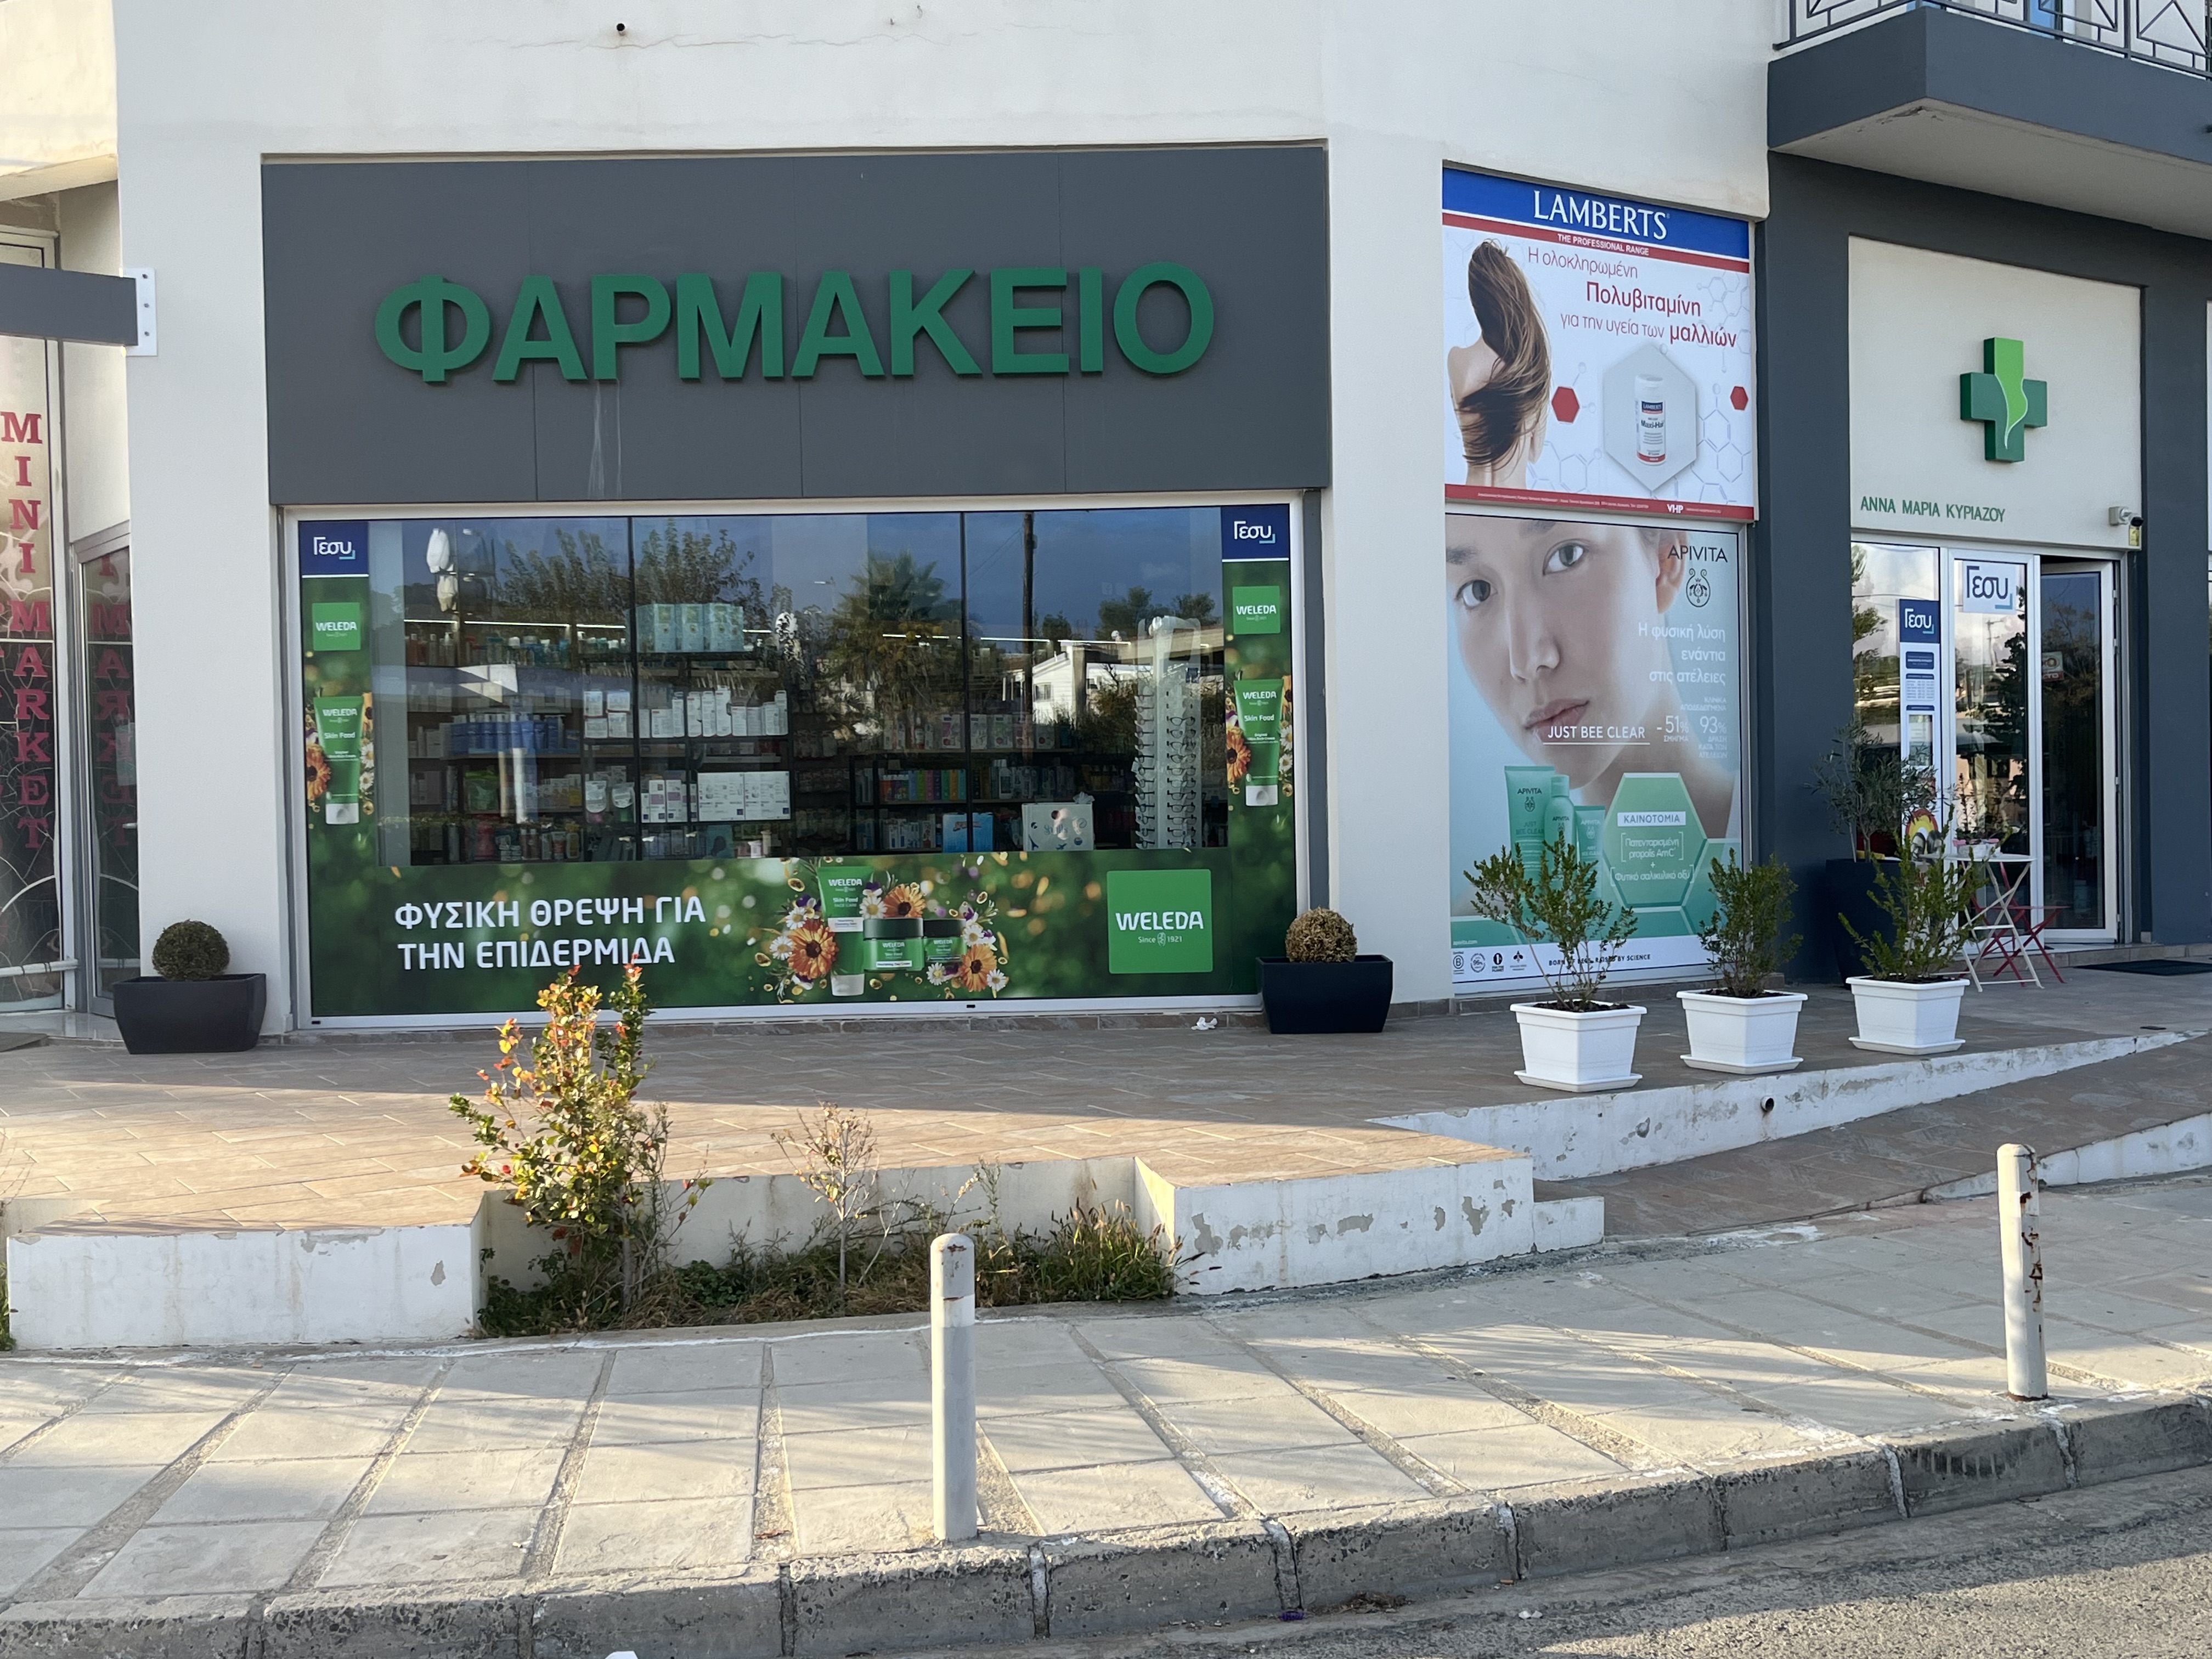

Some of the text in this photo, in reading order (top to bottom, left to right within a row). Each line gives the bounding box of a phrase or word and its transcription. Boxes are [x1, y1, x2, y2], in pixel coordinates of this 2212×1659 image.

[1557, 233, 1650, 256] THE PROFESSIONAL RANGE
[1528, 246, 1638, 279] Η ολοκληρωμένη
[1587, 281, 1701, 318] Πολυβιταμίνη
[374, 262, 1214, 384] ΦΑΡΜΑΚΕΙΟ
[1560, 313, 1737, 348] για την υγεία των μαλλιών
[1666, 504, 1684, 514] VHP
[1860, 496, 2006, 522] ΑΝΝΑ ΜΑΡΙΑ ΚΥΡΙΑΖΟΥ
[1667, 545, 1728, 563] APIVITA
[1236, 605, 1277, 615] WELEDA
[0, 411, 50, 849] MINI MARKET
[315, 621, 357, 631] WELEDA
[1638, 622, 1726, 643] Η φυσική λύση
[1681, 647, 1726, 662] ενάντια
[1649, 668, 1726, 686] στις ατέλειες
[1243, 691, 1277, 700] WELEDA
[322, 708, 358, 716] WELEDA
[1548, 726, 1645, 739] JUST BEE CLEAR
[1700, 715, 1727, 734] 93%
[1623, 814, 1680, 823] ΚΑΙΝΟΤΟΜΙΑ
[828, 878, 862, 887] WELEDA
[395, 895, 706, 930] ΦΥΣΙΚΗ ΘΡΕΨΗ ΓΙΑ
[1115, 911, 1204, 930] WELEDA
[398, 936, 675, 970] ΤΗΝ ΕΠΙΔΕΡΜΙΔΑ
